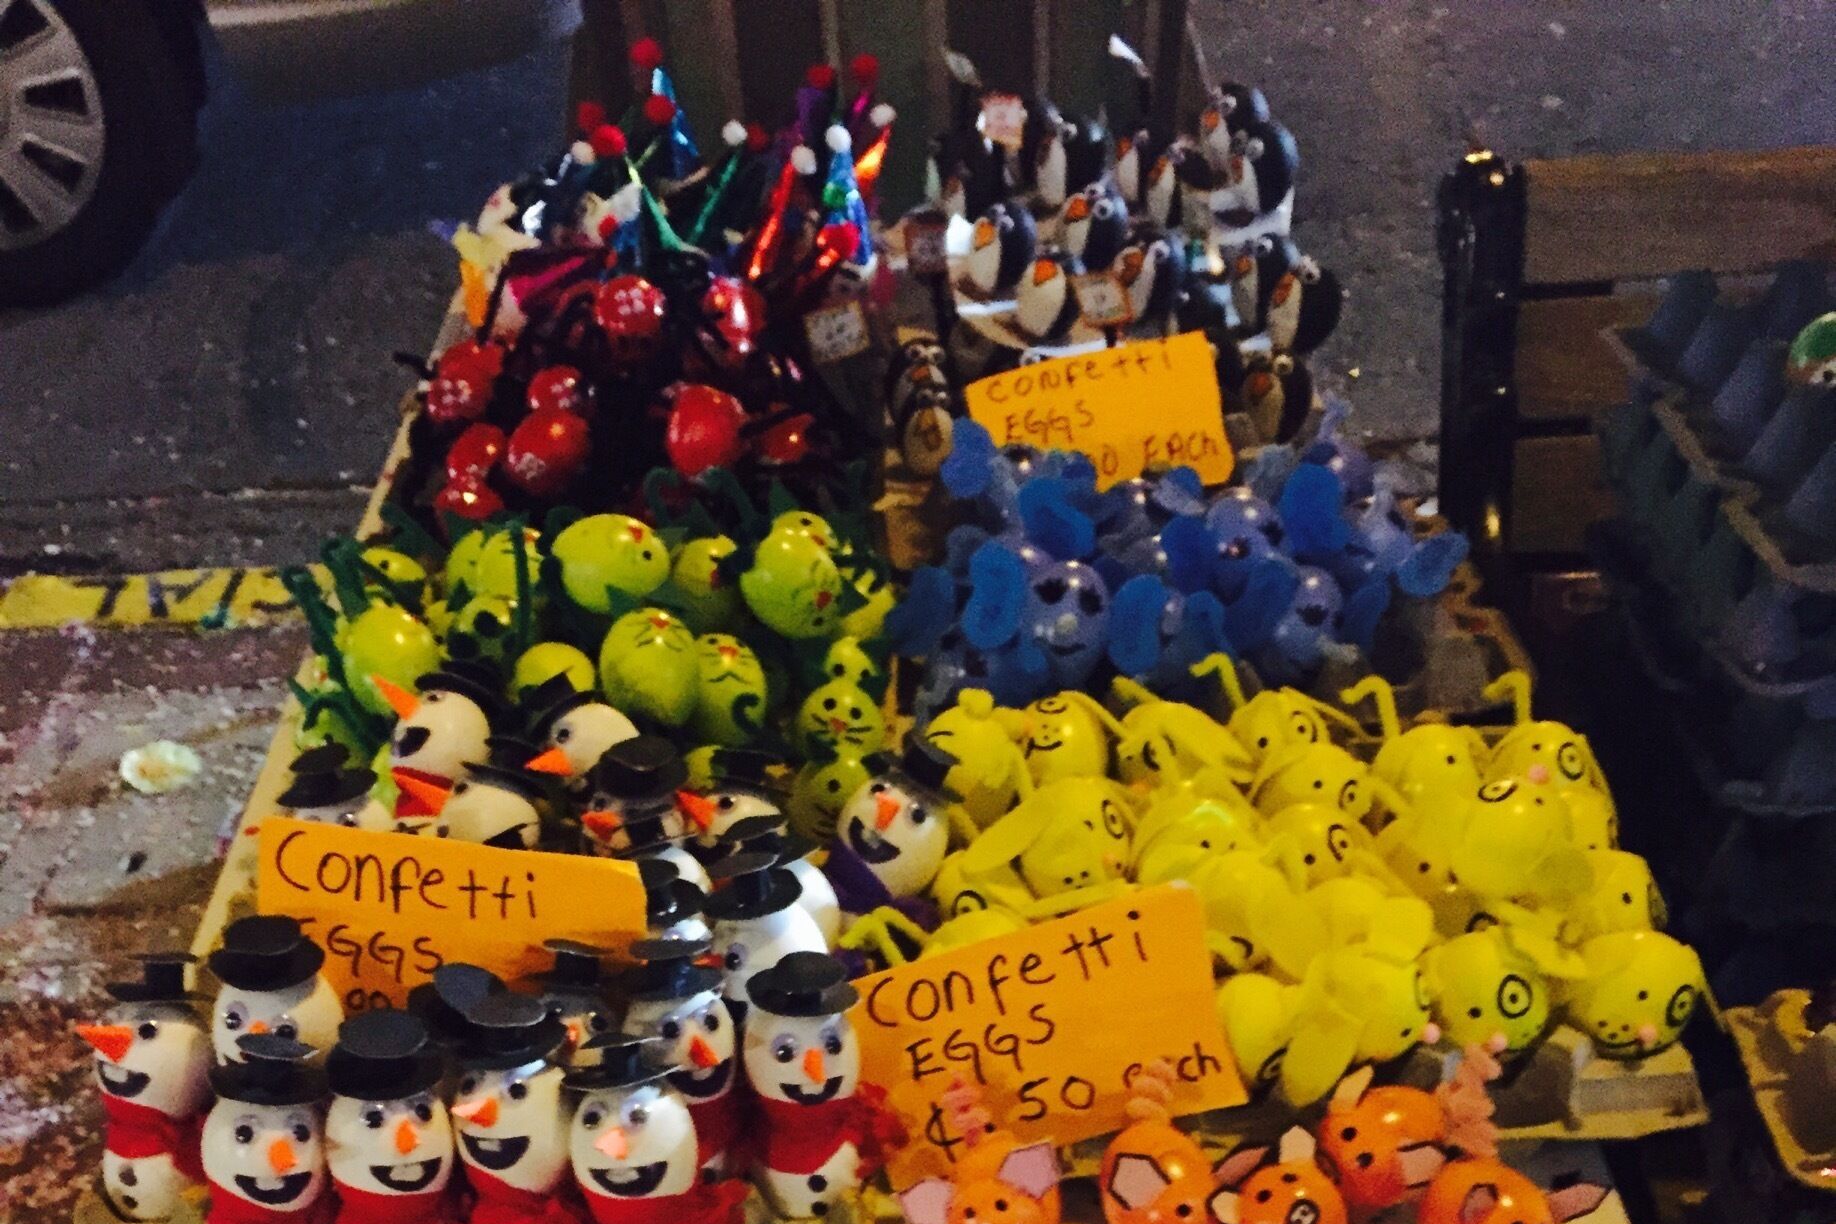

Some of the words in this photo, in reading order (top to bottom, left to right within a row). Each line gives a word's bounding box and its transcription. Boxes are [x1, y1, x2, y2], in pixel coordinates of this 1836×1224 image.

[275, 830, 536, 919] Confetti
[299, 917, 443, 984] GGS
[866, 909, 1149, 1027] Confetti
[906, 1003, 1055, 1085] EGGS
[1122, 1041, 1222, 1089] ech
